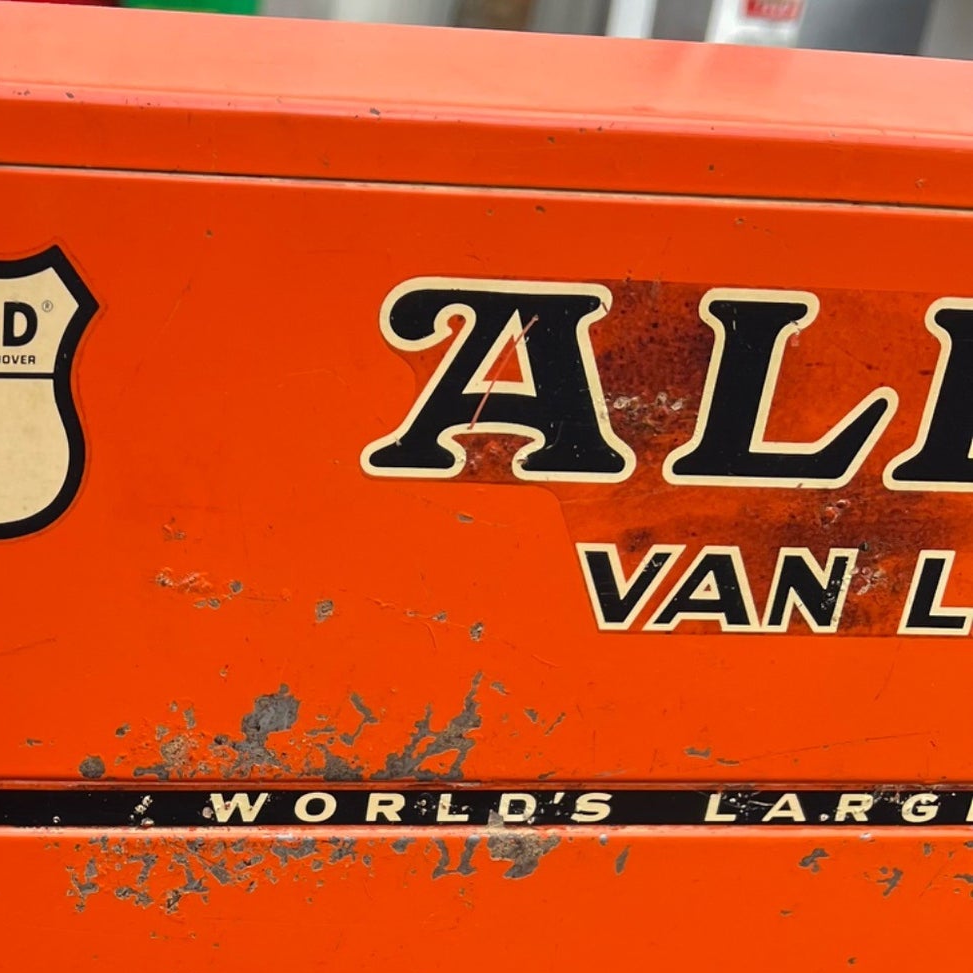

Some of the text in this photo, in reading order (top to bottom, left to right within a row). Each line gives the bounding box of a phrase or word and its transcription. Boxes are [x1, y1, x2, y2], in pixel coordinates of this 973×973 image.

[575, 542, 859, 633] VAN
[209, 792, 973, 823] WORLD'S LARG
